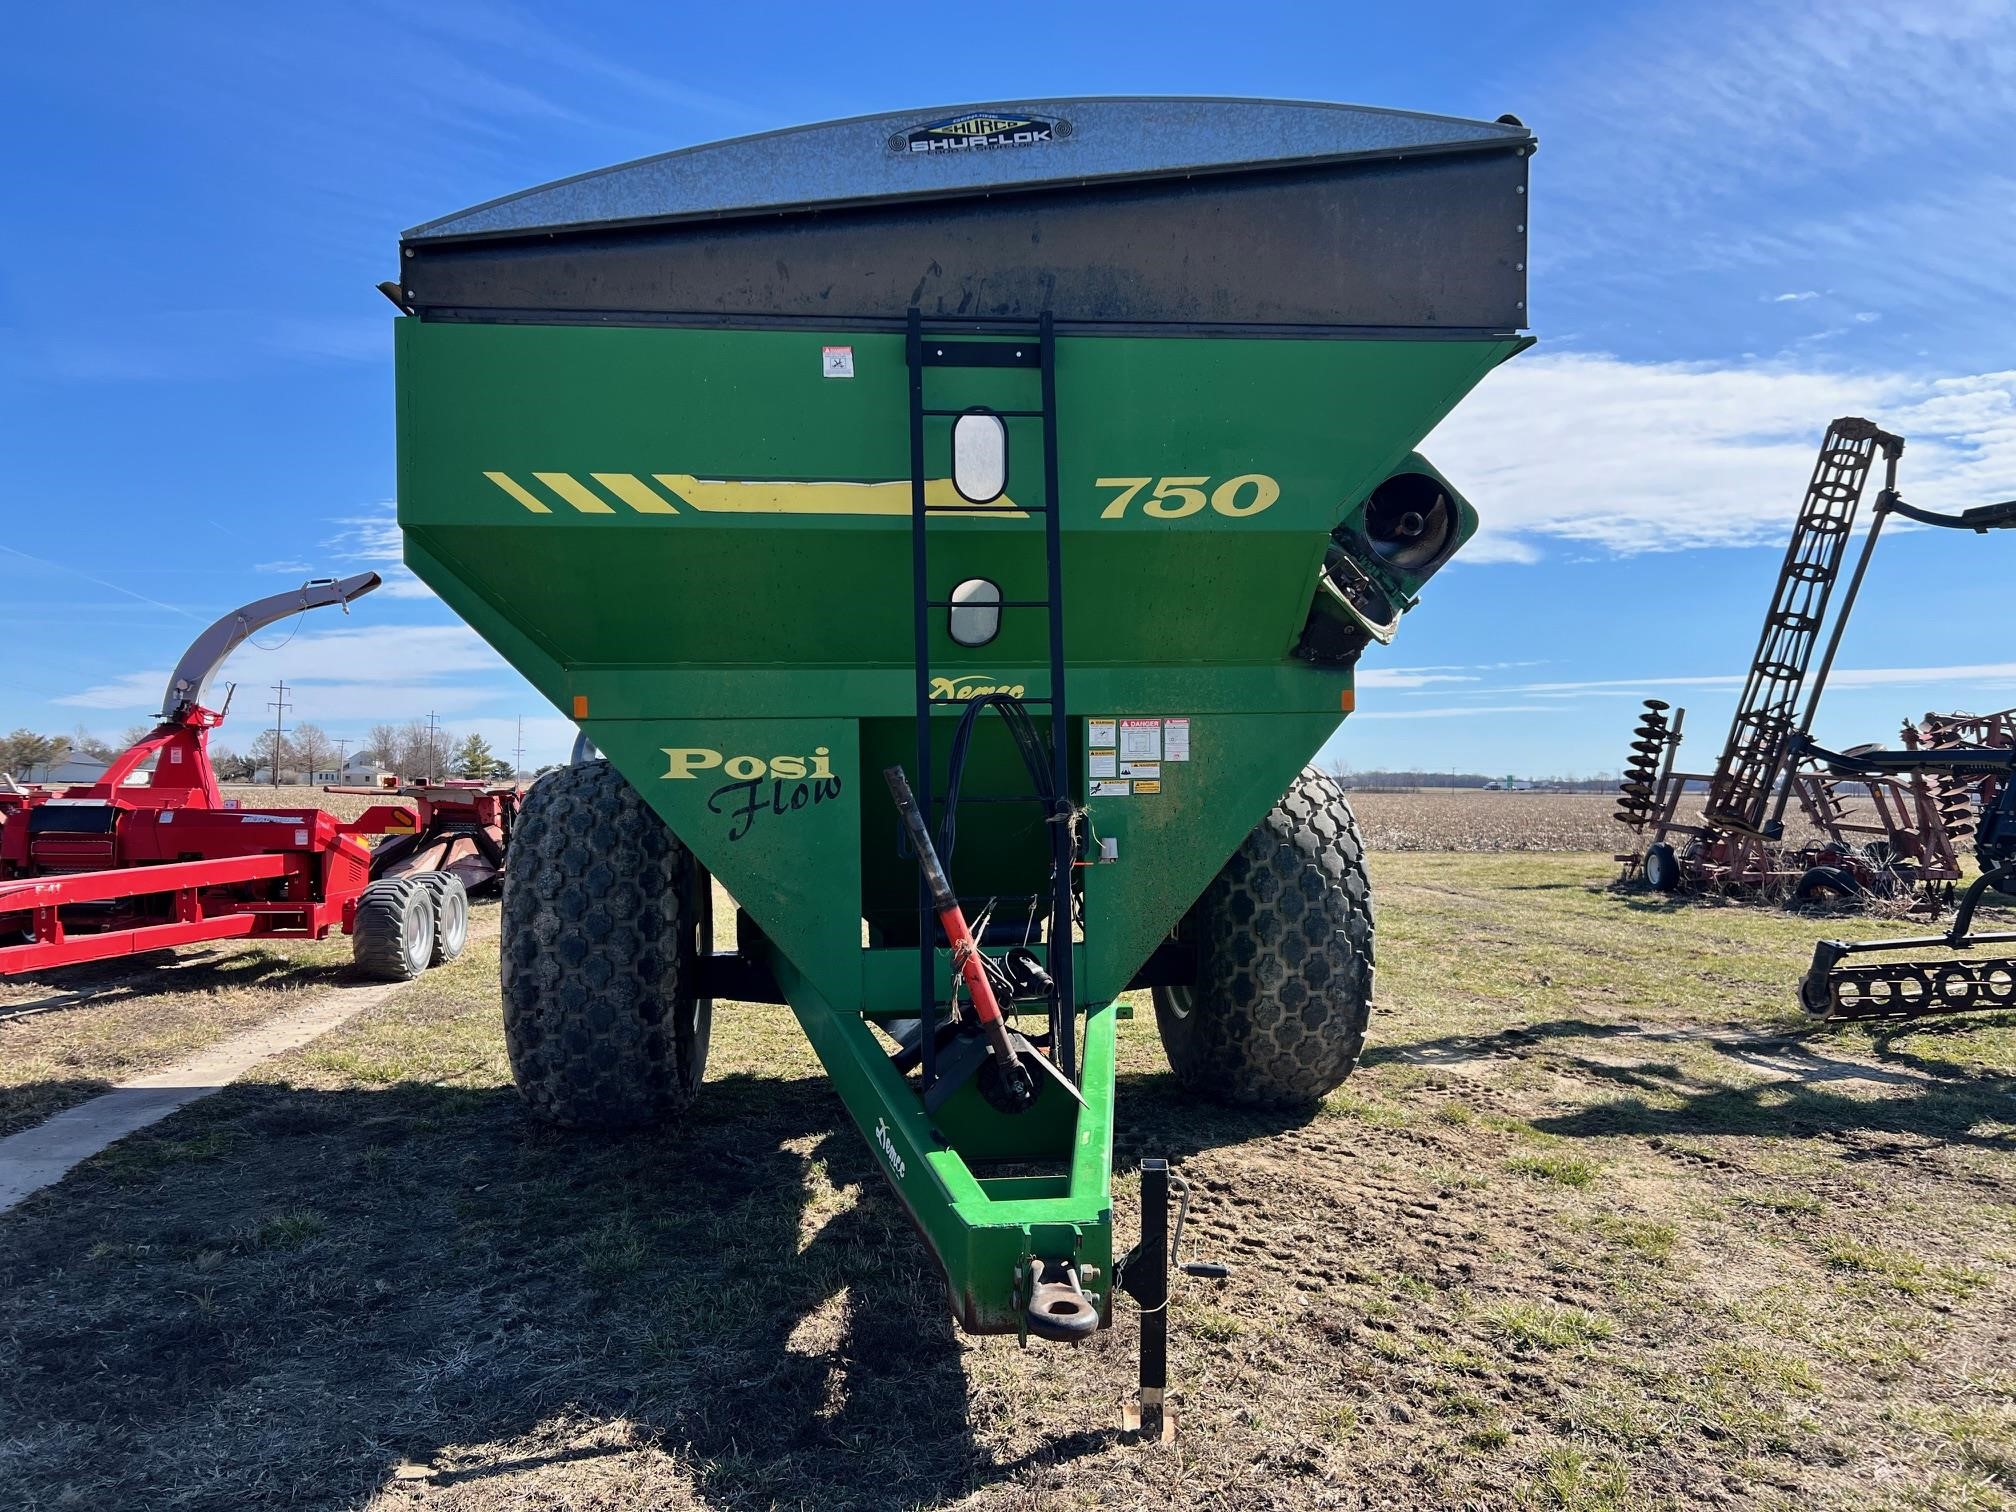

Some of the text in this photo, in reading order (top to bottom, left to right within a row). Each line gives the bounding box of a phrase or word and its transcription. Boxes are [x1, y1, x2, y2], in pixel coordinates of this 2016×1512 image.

[910, 130, 1051, 151] SHUR-LOK
[1095, 474, 1280, 519] 750
[659, 747, 836, 780] Posi
[708, 776, 842, 842] Flow
